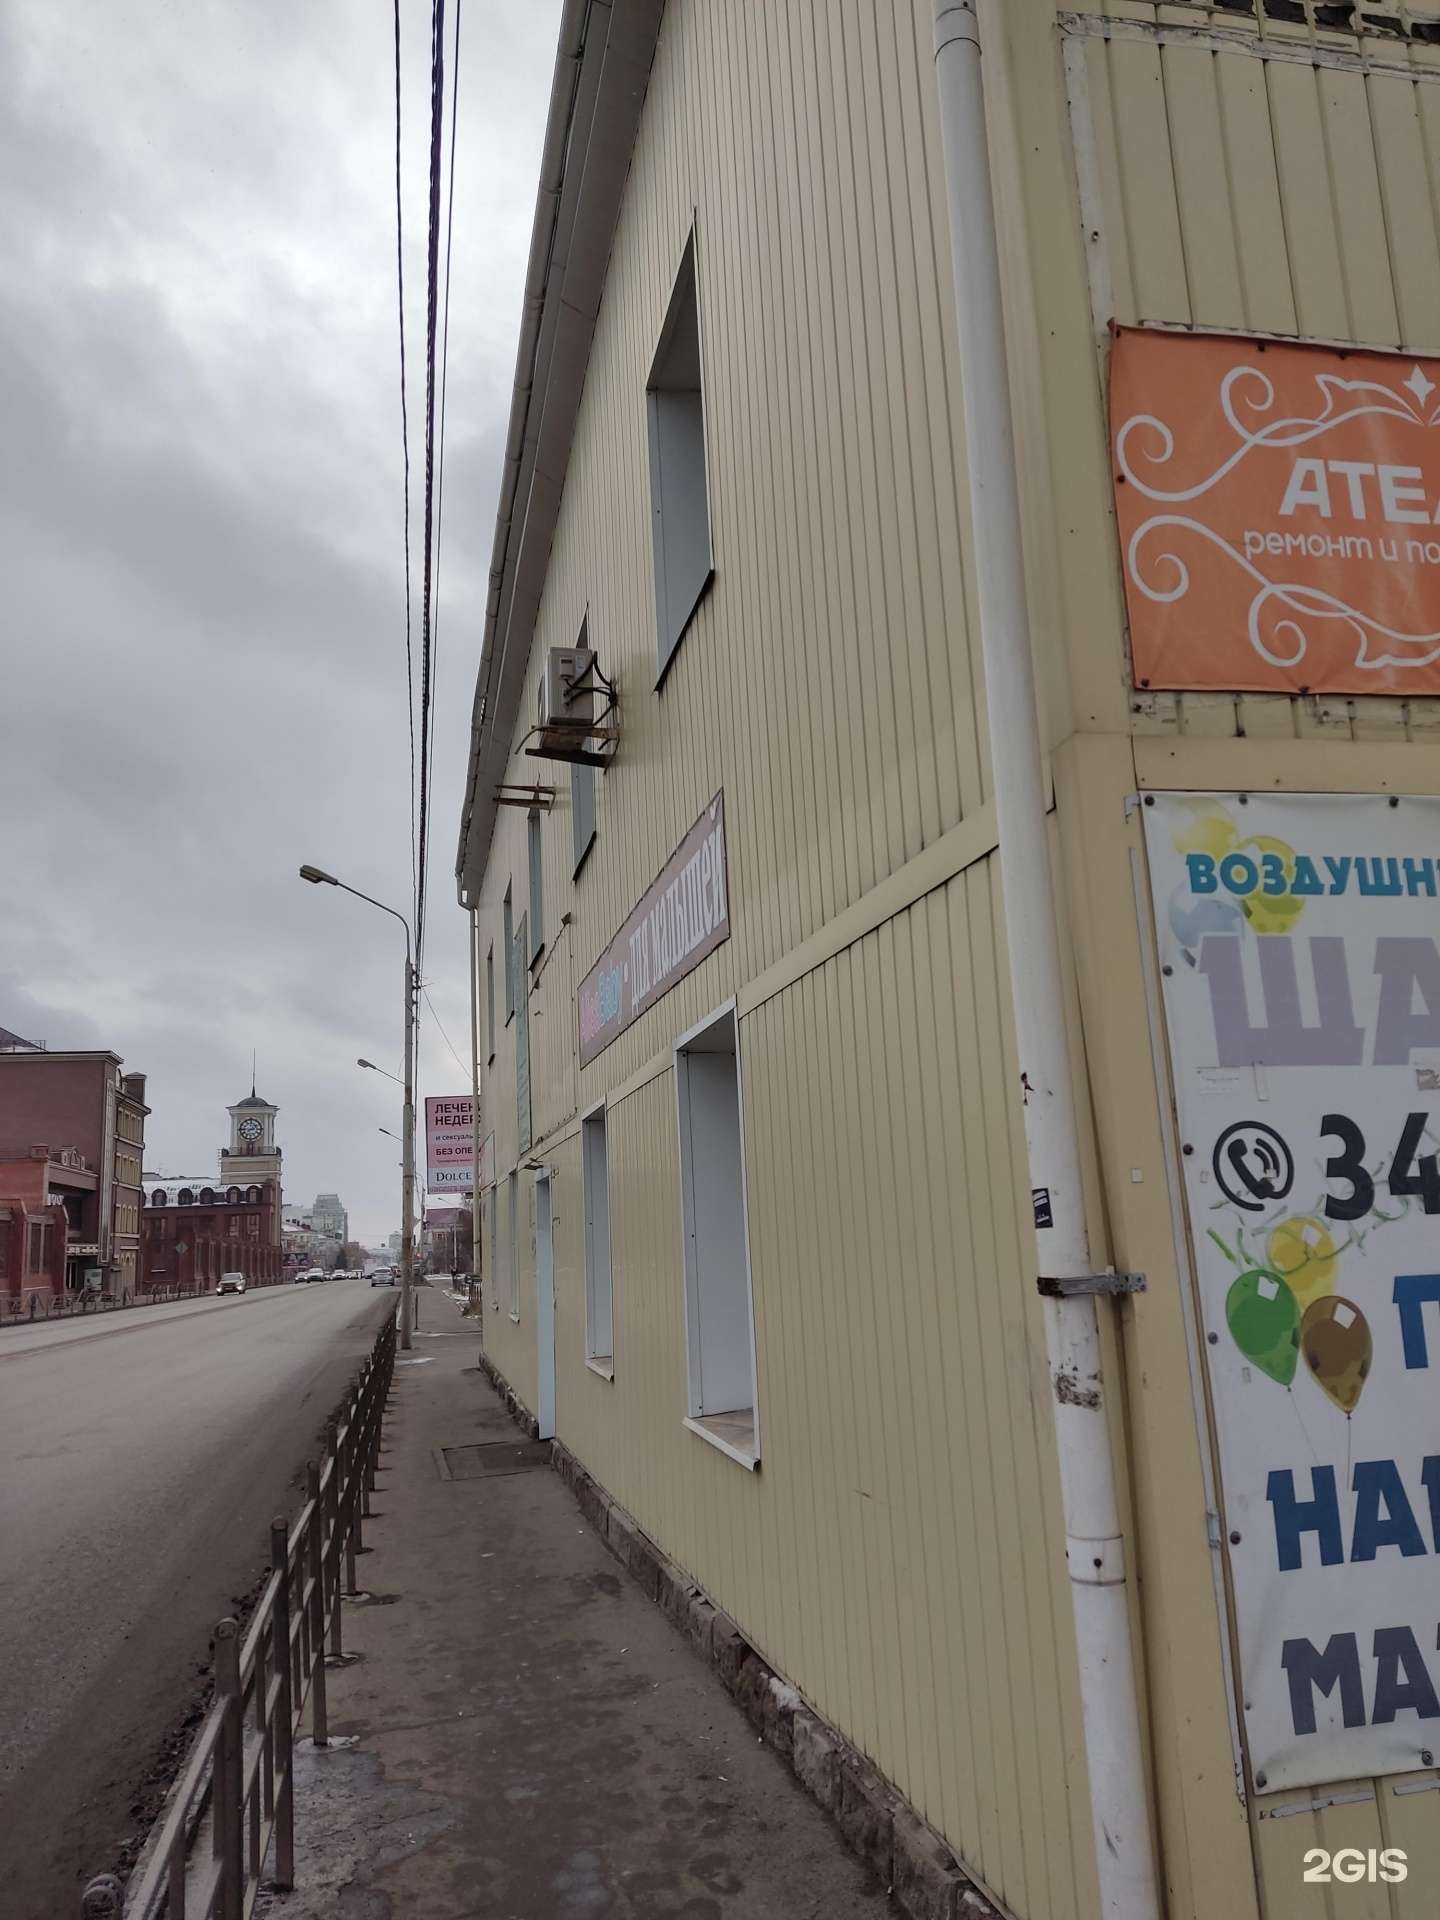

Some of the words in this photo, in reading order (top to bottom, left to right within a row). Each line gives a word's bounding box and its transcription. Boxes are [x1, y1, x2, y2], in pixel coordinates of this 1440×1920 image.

[1279, 458, 1440, 525] АТЕ
[1243, 529, 1373, 561] ремонт
[1380, 540, 1397, 559] и
[1406, 539, 1440, 564] по
[1184, 853, 1440, 898] ВОЗДУШН
[436, 1148, 453, 1156] БЕЗ
[455, 1147, 473, 1155] ОПЕ
[1320, 1112, 1440, 1221] 34
[1266, 1456, 1440, 1573] НА
[1281, 1623, 1440, 1736] МА
